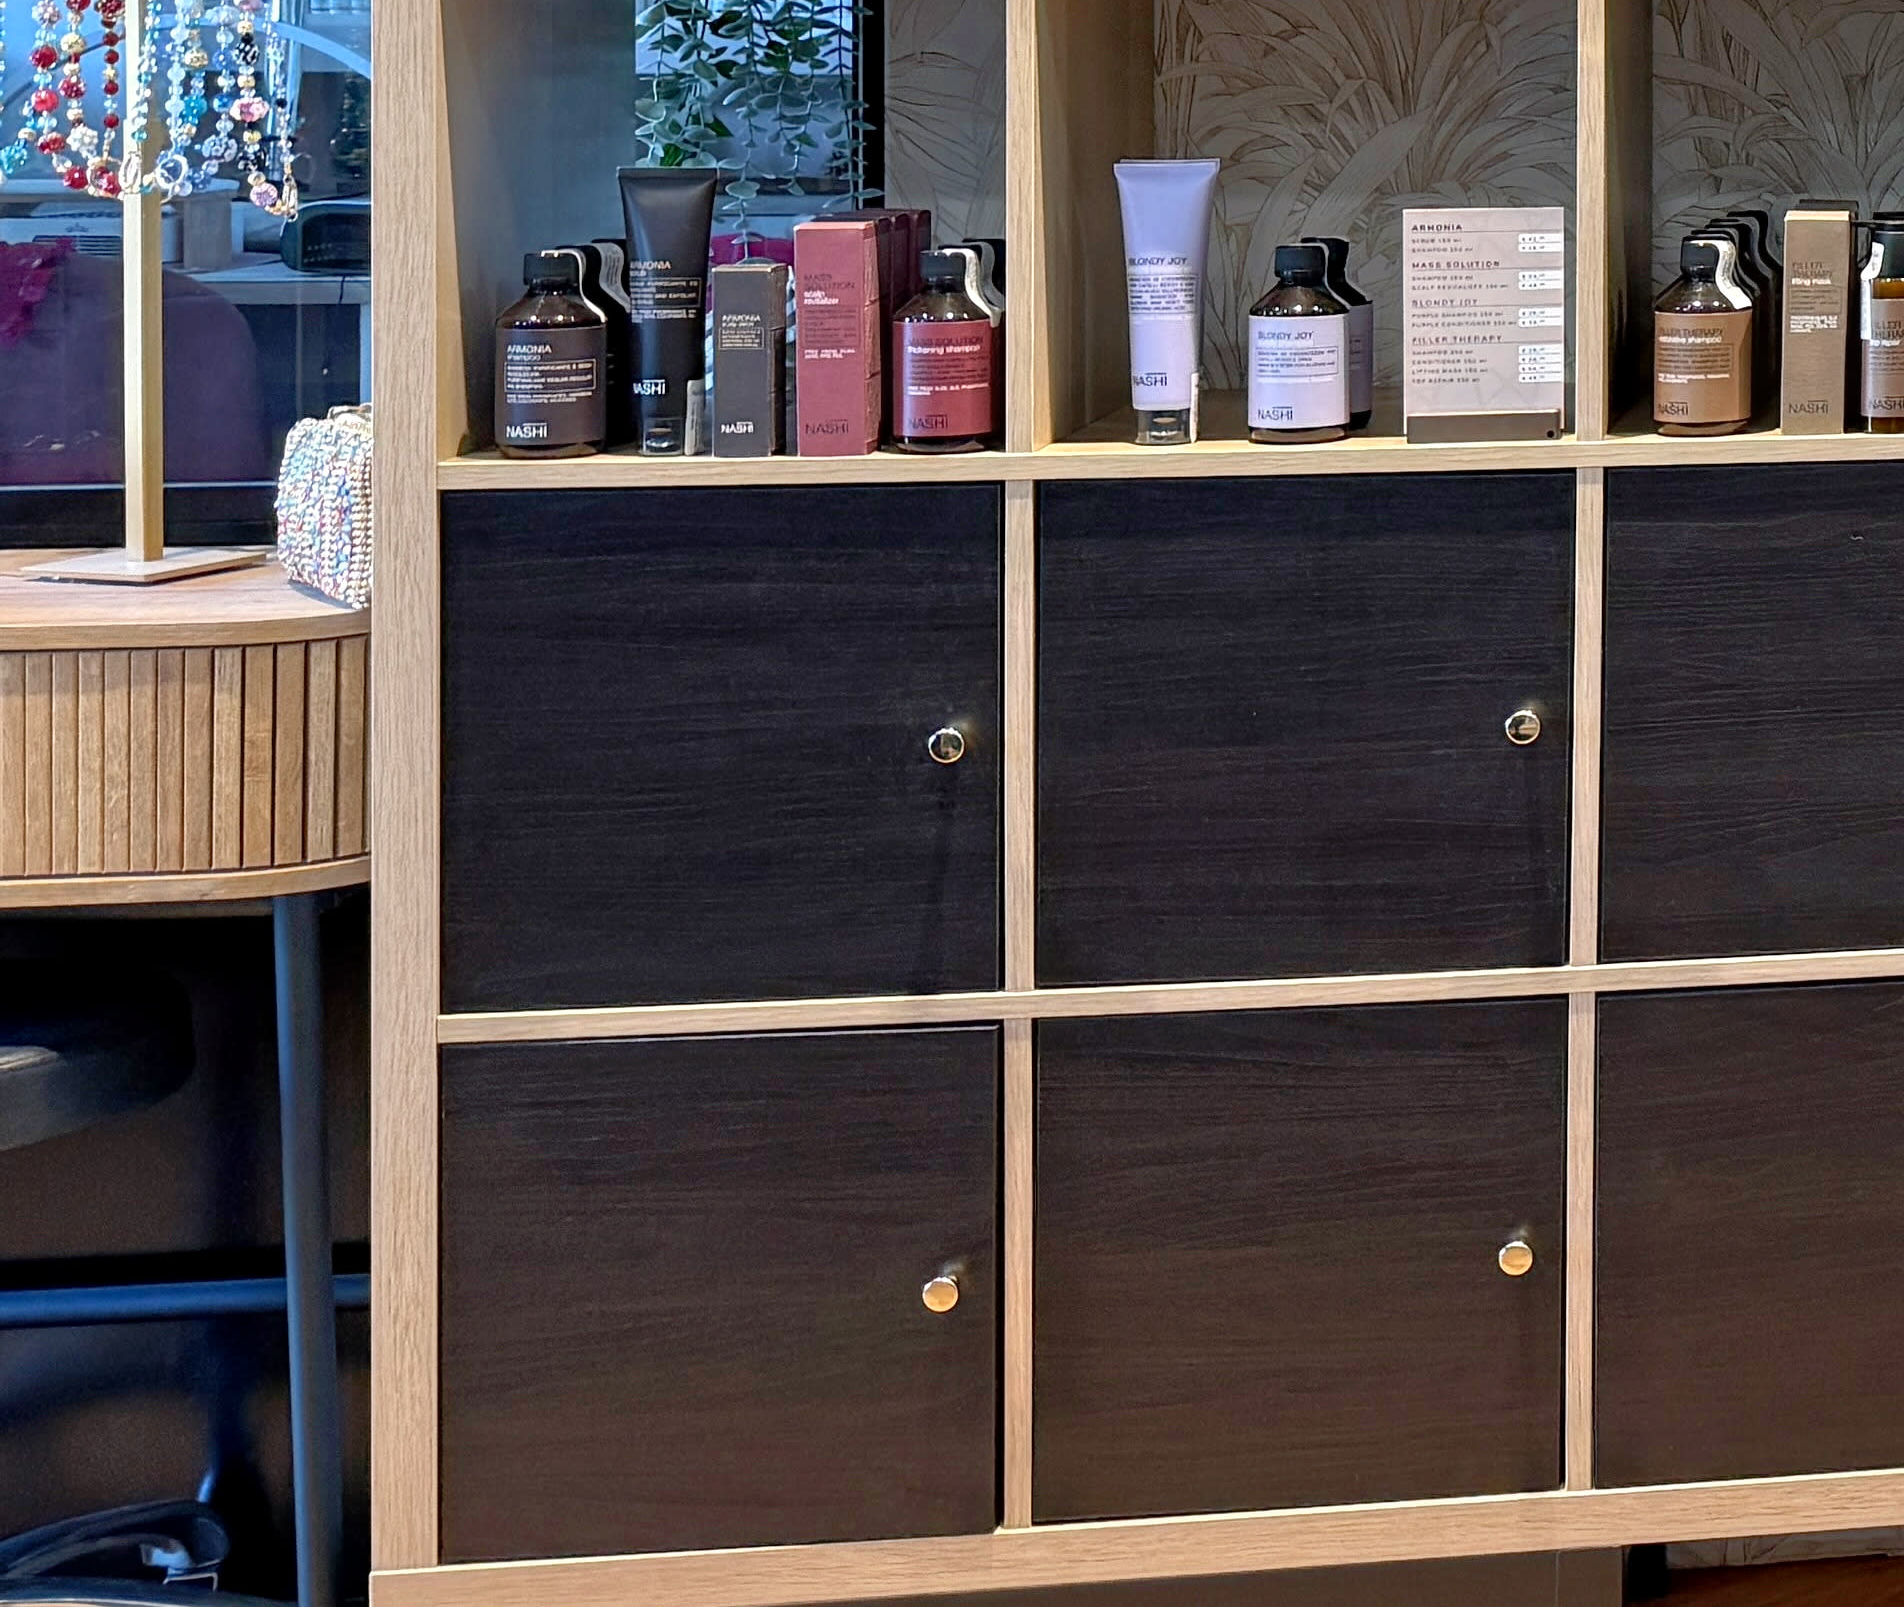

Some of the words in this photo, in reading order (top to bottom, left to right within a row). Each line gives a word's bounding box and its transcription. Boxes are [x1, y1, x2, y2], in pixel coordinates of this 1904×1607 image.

[1168, 257, 1187, 265] JOY
[1446, 261, 1500, 269] SOLUTION
[1257, 331, 1291, 340] BLONDY
[1294, 331, 1313, 340] JOY
[507, 344, 552, 354] ARMONIA
[1133, 375, 1167, 386] NASHI
[1258, 408, 1293, 420] NASHI
[1658, 403, 1688, 415] NASHI
[1788, 403, 1828, 414] NASHI
[805, 422, 849, 434] NASHI
[908, 417, 948, 429] NASHI
[506, 425, 547, 438] NASHI
